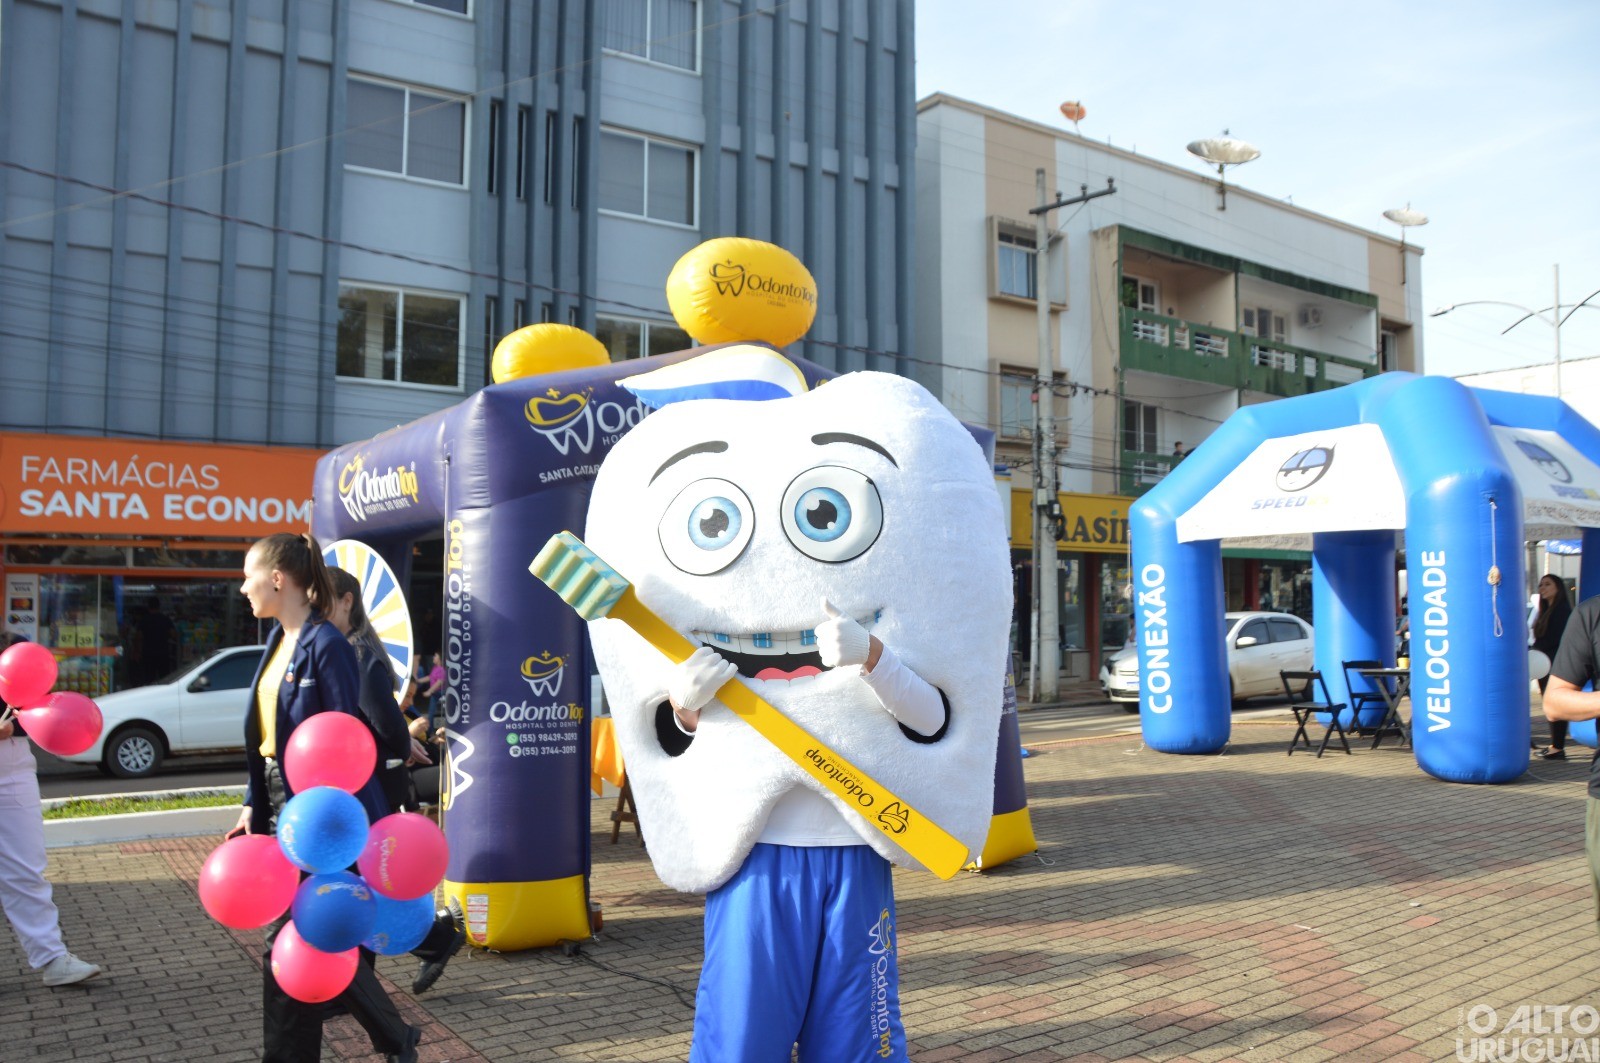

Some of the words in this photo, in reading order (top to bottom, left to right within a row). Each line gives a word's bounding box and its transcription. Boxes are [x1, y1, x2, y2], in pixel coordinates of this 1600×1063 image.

[21, 454, 220, 491] FARMÁCIAS
[360, 465, 419, 504] OdontoTop
[539, 467, 574, 483] SANTA
[19, 489, 150, 520] SANTA
[463, 563, 472, 613] DENTE
[445, 519, 465, 724] OdontoTop
[463, 620, 472, 641] DO
[1138, 563, 1173, 714] CONEXÃO
[1421, 550, 1452, 732] VELOCIDADE
[462, 649, 472, 724] HOSPITAL
[489, 700, 584, 724] OdontoTop
[505, 722, 544, 730] HOSPITAL
[560, 720, 577, 728] DENTE
[519, 733, 536, 744] (55)
[522, 746, 539, 756] (55)
[876, 955, 892, 1058] OdontoTop
[870, 1014, 879, 1040] DENTE
